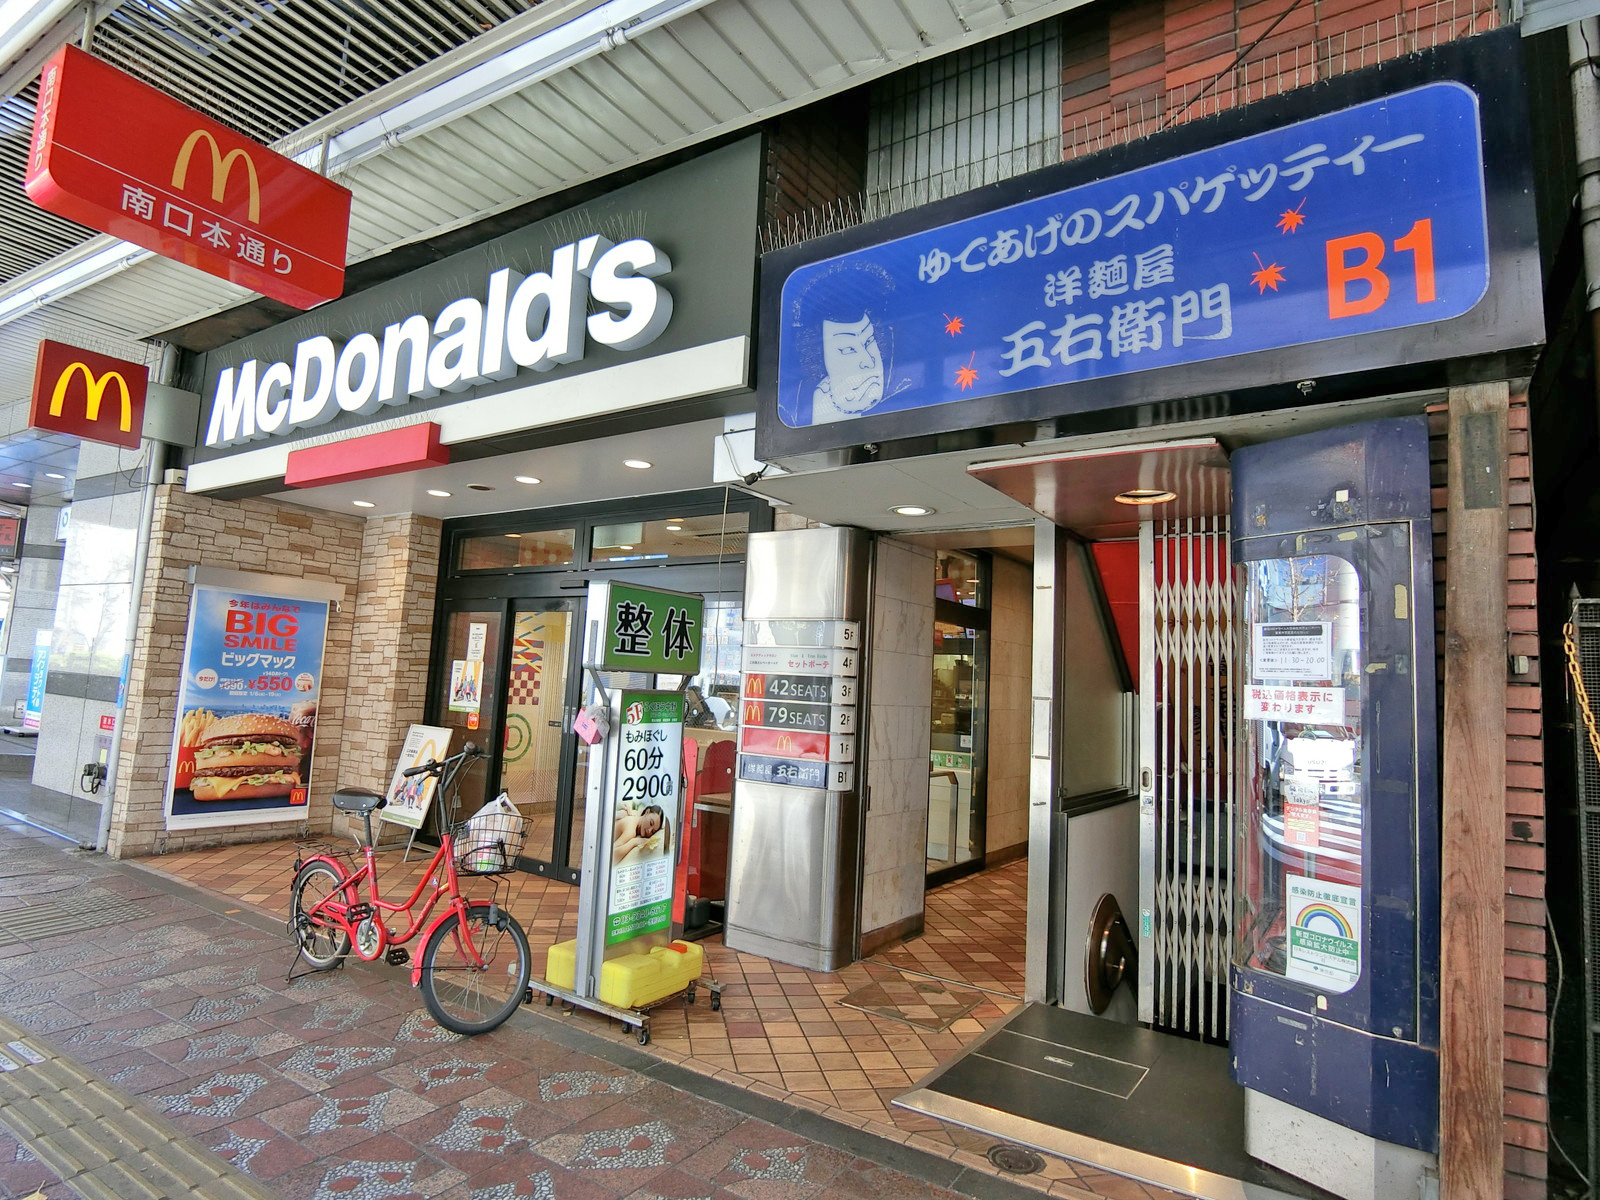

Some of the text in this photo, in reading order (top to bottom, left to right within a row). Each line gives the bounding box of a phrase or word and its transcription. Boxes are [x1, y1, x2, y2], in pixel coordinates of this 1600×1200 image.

[35, 66, 57, 172] 南口本通り
[918, 133, 1425, 283] ゆであげのスパゲッティー
[121, 184, 293, 274] 南口本通り
[1326, 219, 1437, 320] B1
[205, 234, 670, 447] McDonald's
[229, 599, 300, 614] 今年はみんなで
[225, 609, 299, 637] BIG
[613, 600, 695, 660] 整体
[223, 634, 297, 652] SMILE
[843, 628, 853, 640] 5F
[221, 651, 296, 669] ビッグマック
[842, 656, 852, 668] 4F
[248, 676, 293, 691] ¥550
[769, 680, 790, 696] 42
[790, 683, 827, 698] SEATS
[841, 685, 851, 697] 3F
[1252, 688, 1334, 702] 税込価格表示に
[625, 701, 643, 725] 5F
[769, 707, 788, 723] 79
[789, 712, 826, 727] SEATS
[1261, 702, 1316, 714] 変わります
[840, 713, 850, 725] 2F
[625, 729, 668, 743] もみほぐし
[839, 743, 849, 755] 1F
[624, 746, 664, 771] 60分
[837, 771, 847, 783] B1
[1291, 886, 1357, 906] 感染防止徹底宣言
[1295, 929, 1354, 950] 新型コロナウイルス
[1299, 938, 1350, 956] 感染拡大防止中
